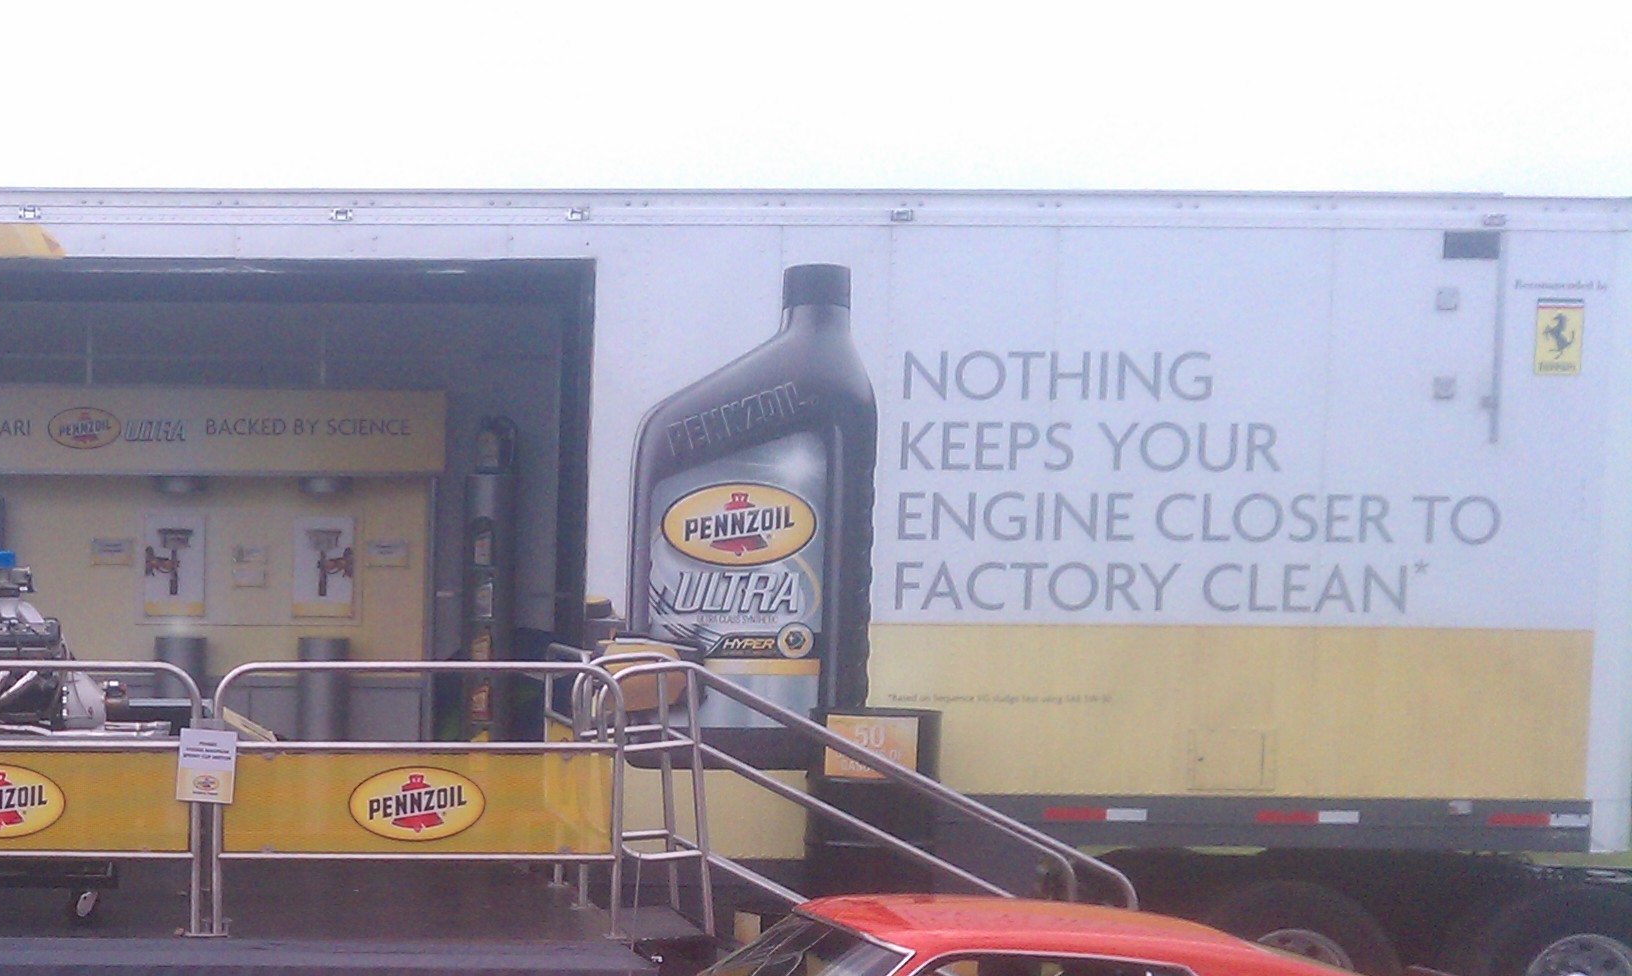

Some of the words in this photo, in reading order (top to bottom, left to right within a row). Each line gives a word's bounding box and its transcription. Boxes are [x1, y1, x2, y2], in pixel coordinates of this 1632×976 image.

[903, 350, 1214, 401] NOTHING
[59, 419, 112, 437] PENNZOIL
[205, 418, 286, 436] BACKED
[293, 418, 319, 436] BY
[326, 418, 411, 436] SCIENCE
[668, 381, 805, 457] PENNZOIL
[899, 421, 1075, 472] KEEPS
[1098, 421, 1281, 473] YOUR
[684, 506, 796, 542] PENNZOIL
[897, 491, 1135, 542] ENGINE
[1155, 492, 1394, 543] CLOSER
[1413, 495, 1502, 545] TO
[673, 571, 800, 614] ULTRA
[894, 560, 1182, 612] FACTORY
[722, 638, 775, 650] HYPER
[855, 724, 885, 748] 50
[369, 785, 467, 820] PENNZOIL
